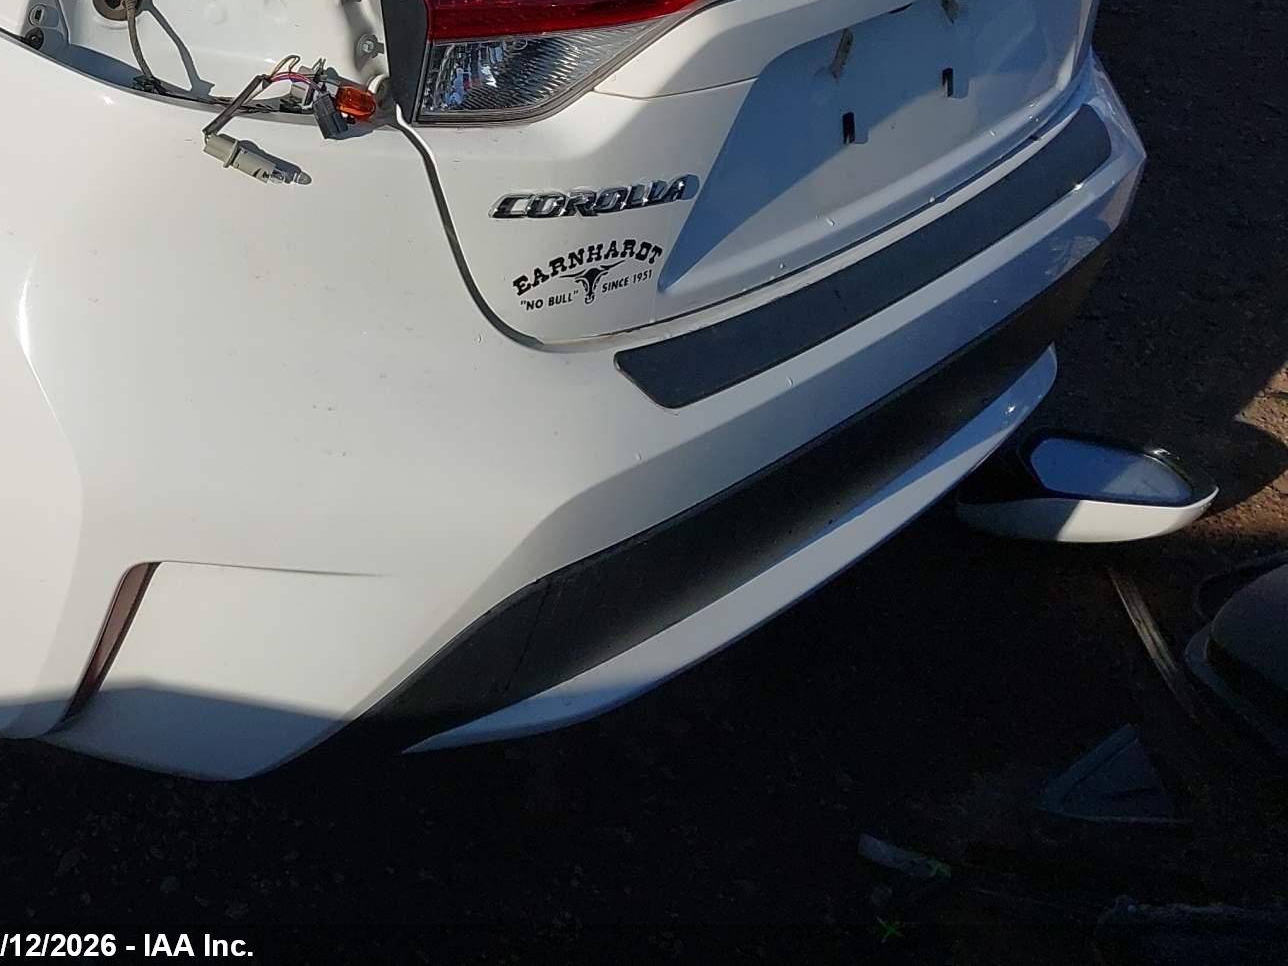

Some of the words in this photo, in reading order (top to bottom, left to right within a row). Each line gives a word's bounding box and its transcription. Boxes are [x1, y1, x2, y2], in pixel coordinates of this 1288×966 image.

[488, 174, 700, 219] COROLLA
[512, 239, 664, 297] EARNHARDT
[601, 277, 630, 294] SINCE
[632, 269, 654, 285] 1951
